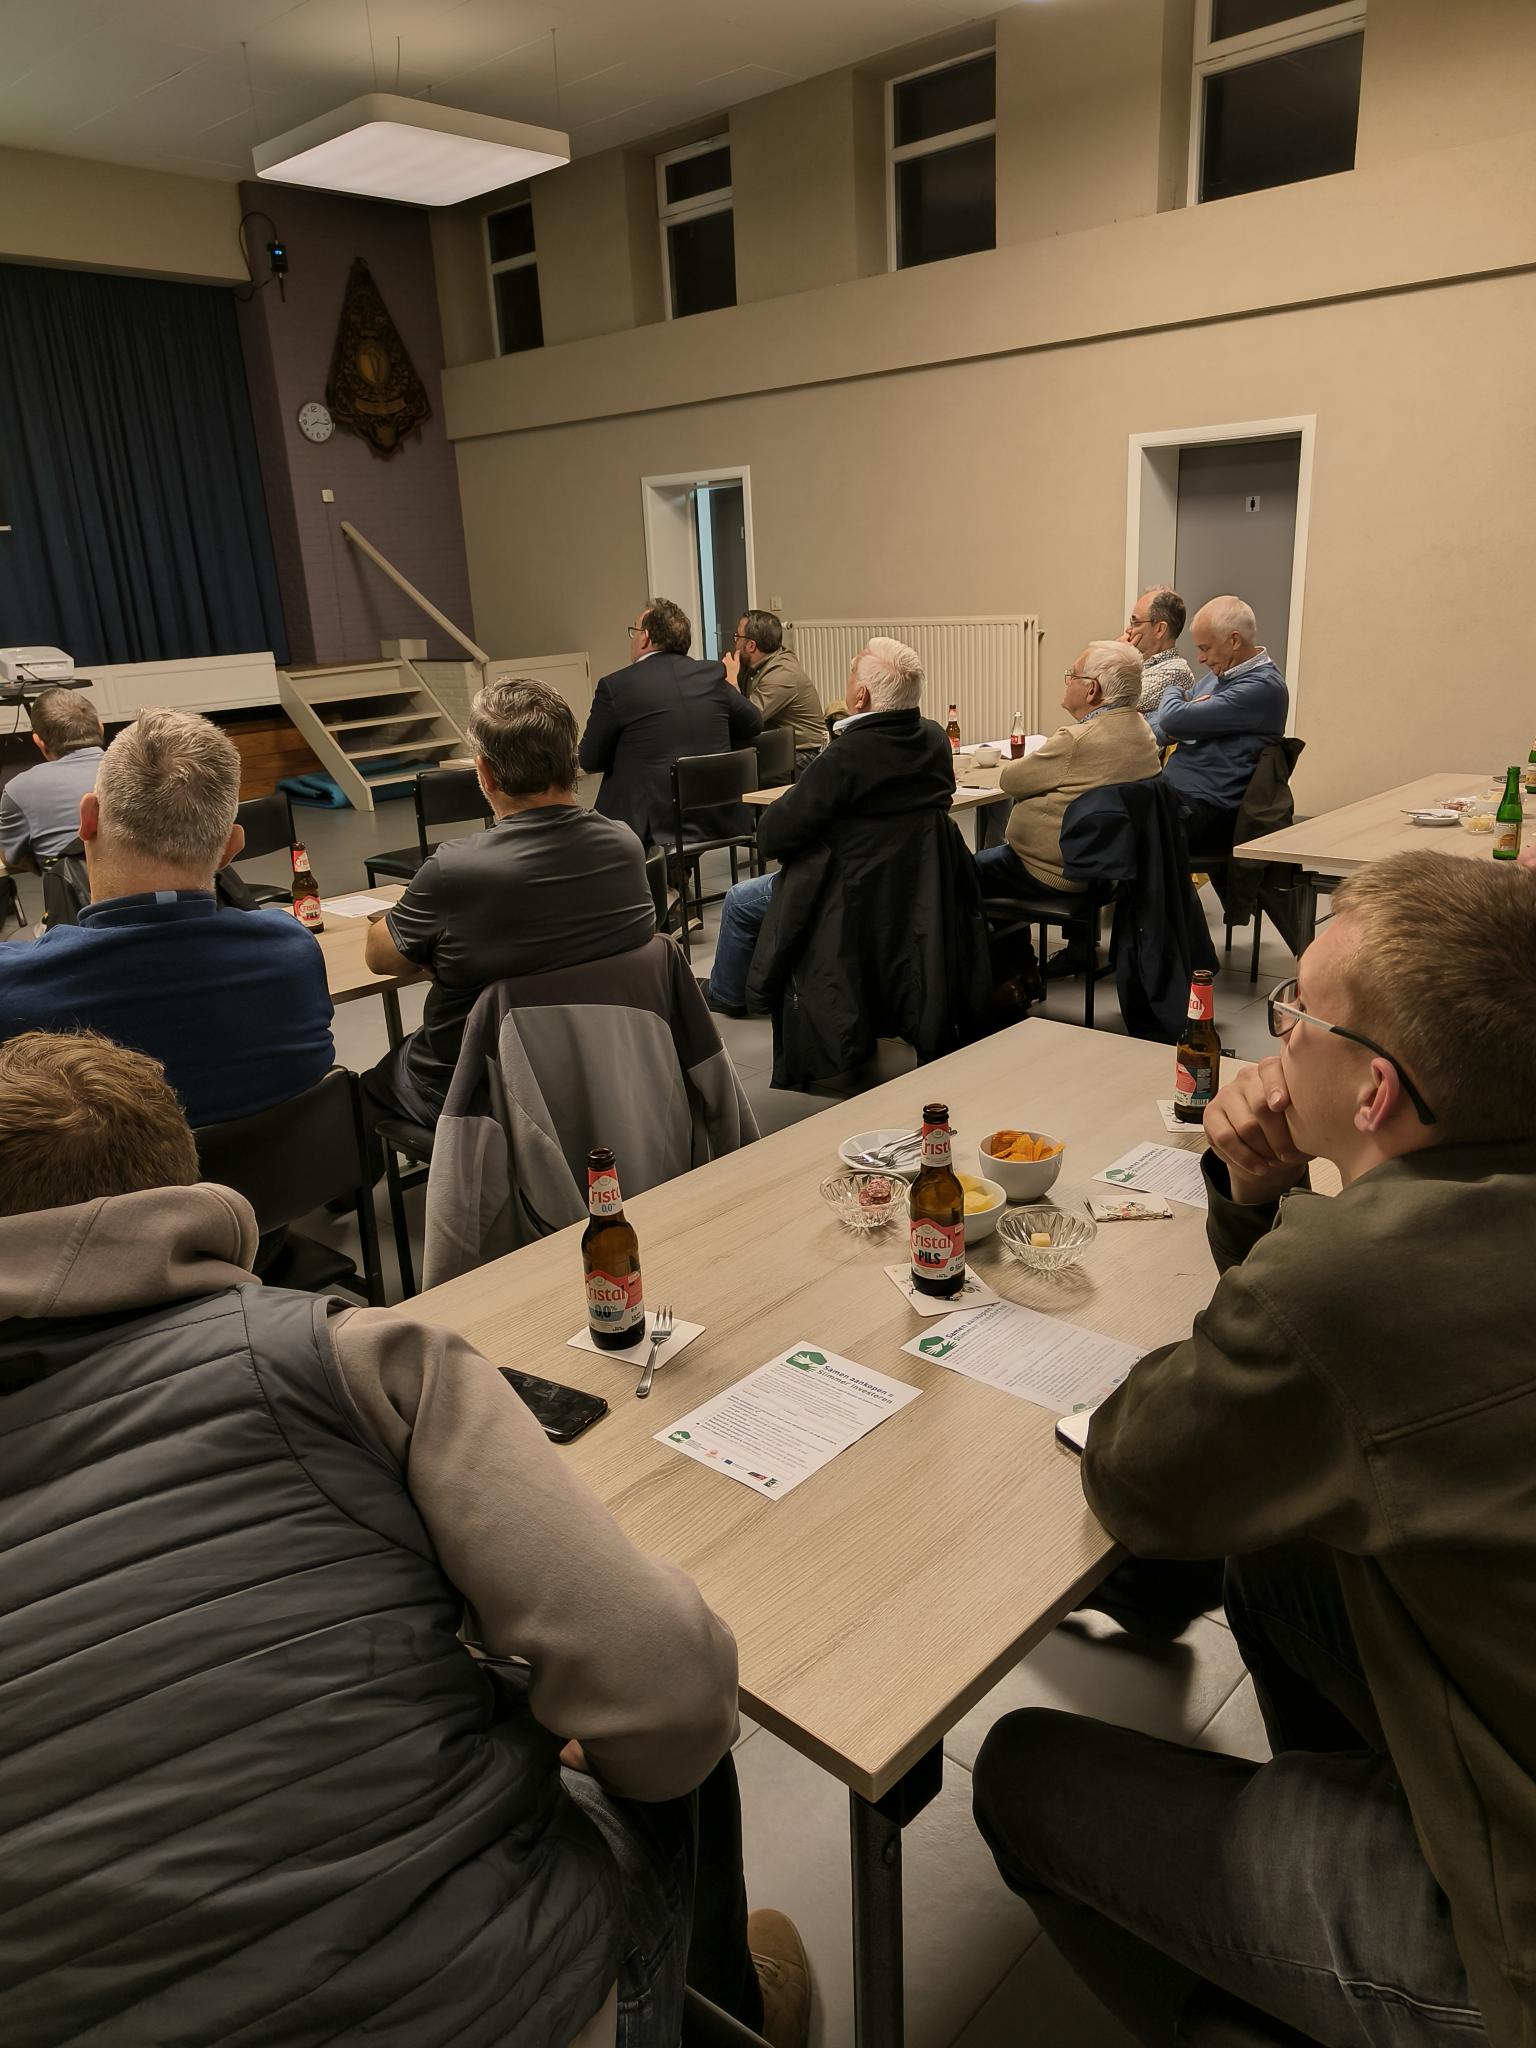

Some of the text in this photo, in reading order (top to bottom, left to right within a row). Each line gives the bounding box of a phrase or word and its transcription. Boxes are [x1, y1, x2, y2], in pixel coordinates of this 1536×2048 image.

[911, 1228, 951, 1249] Cristal
[918, 1249, 942, 1265] PILS
[816, 1369, 894, 1405] Slimmer investeren
[823, 1365, 850, 1380] Samen
[849, 1375, 888, 1396] aankopen
